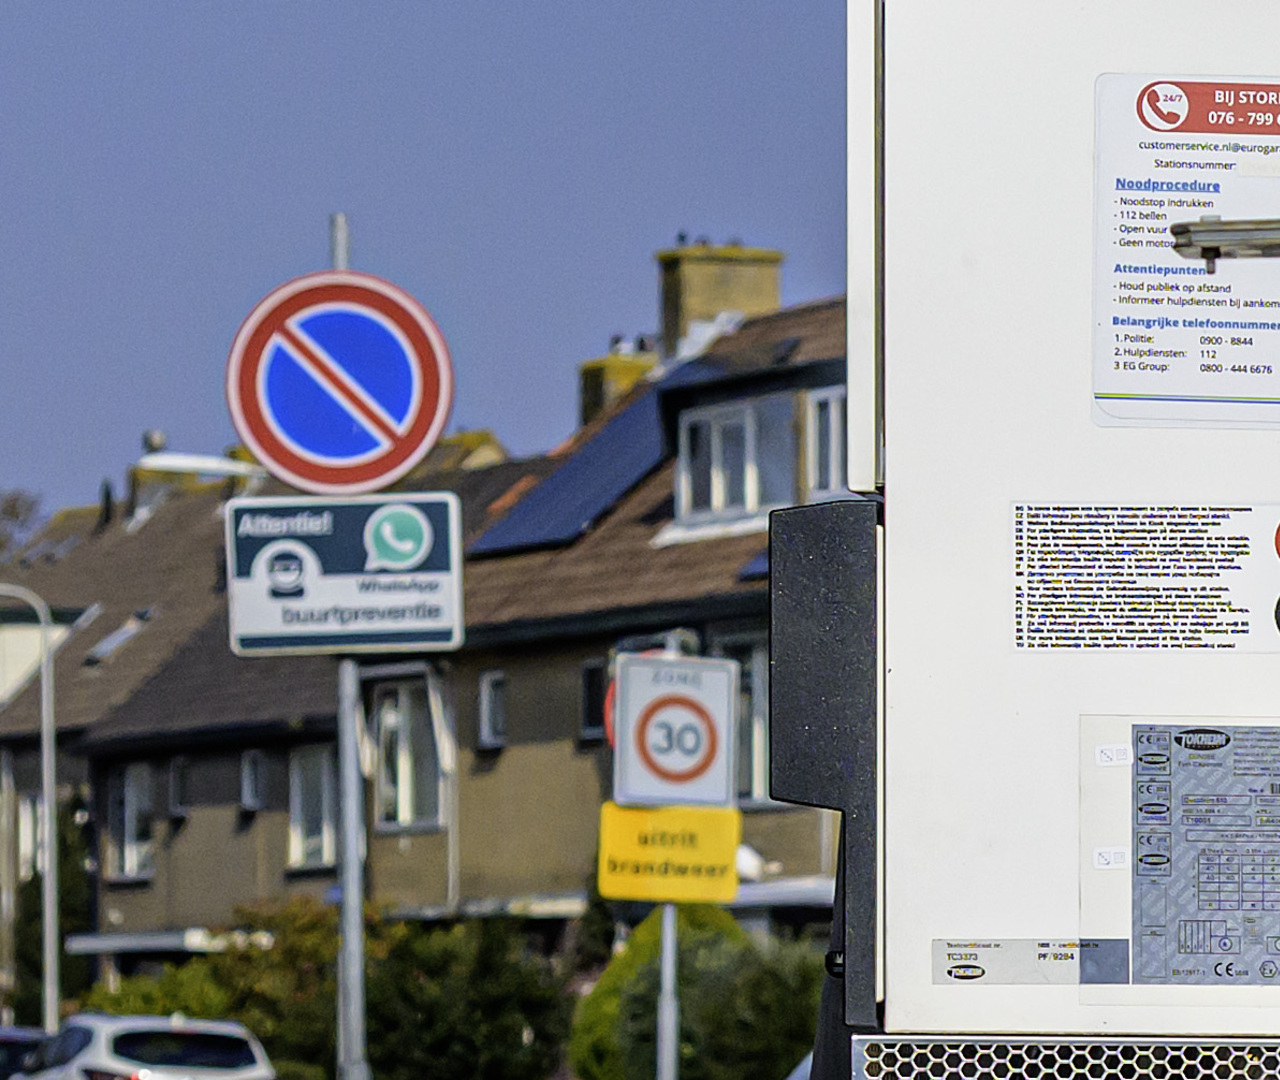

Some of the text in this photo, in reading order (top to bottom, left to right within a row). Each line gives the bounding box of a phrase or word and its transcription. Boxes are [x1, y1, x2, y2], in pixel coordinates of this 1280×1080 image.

[1214, 90, 1235, 106] BIJ
[1208, 111, 1235, 124] 076
[1247, 112, 1274, 125] 799
[1115, 178, 1221, 193] Noodprocedure
[1120, 197, 1214, 208] Noodstop indrukken
[1120, 211, 1168, 220] 112 bellen
[1119, 224, 1168, 235] Open vuur
[1119, 237, 1144, 247] Geen
[1113, 263, 1207, 277] Attentiepunten
[1119, 281, 1232, 293] Houd publiek op afstand
[1119, 295, 1165, 305] Informeer
[1167, 296, 1227, 308] hulpdiensten
[1229, 298, 1241, 309] bij
[1112, 316, 1180, 330] Belangrijke
[1200, 335, 1223, 345] 0900
[1230, 336, 1254, 346] 8844
[1200, 349, 1217, 359] 112
[1123, 361, 1136, 371] EG
[1200, 363, 1223, 373] 0800
[1230, 364, 1248, 374] 444
[1249, 364, 1273, 375] 6676
[237, 510, 334, 537] Attentie!
[356, 578, 440, 594] WhatsApp
[281, 603, 442, 624] buurtpreventie
[652, 720, 703, 756] 30
[638, 828, 698, 848] uitrit
[606, 855, 729, 878] brandweer
